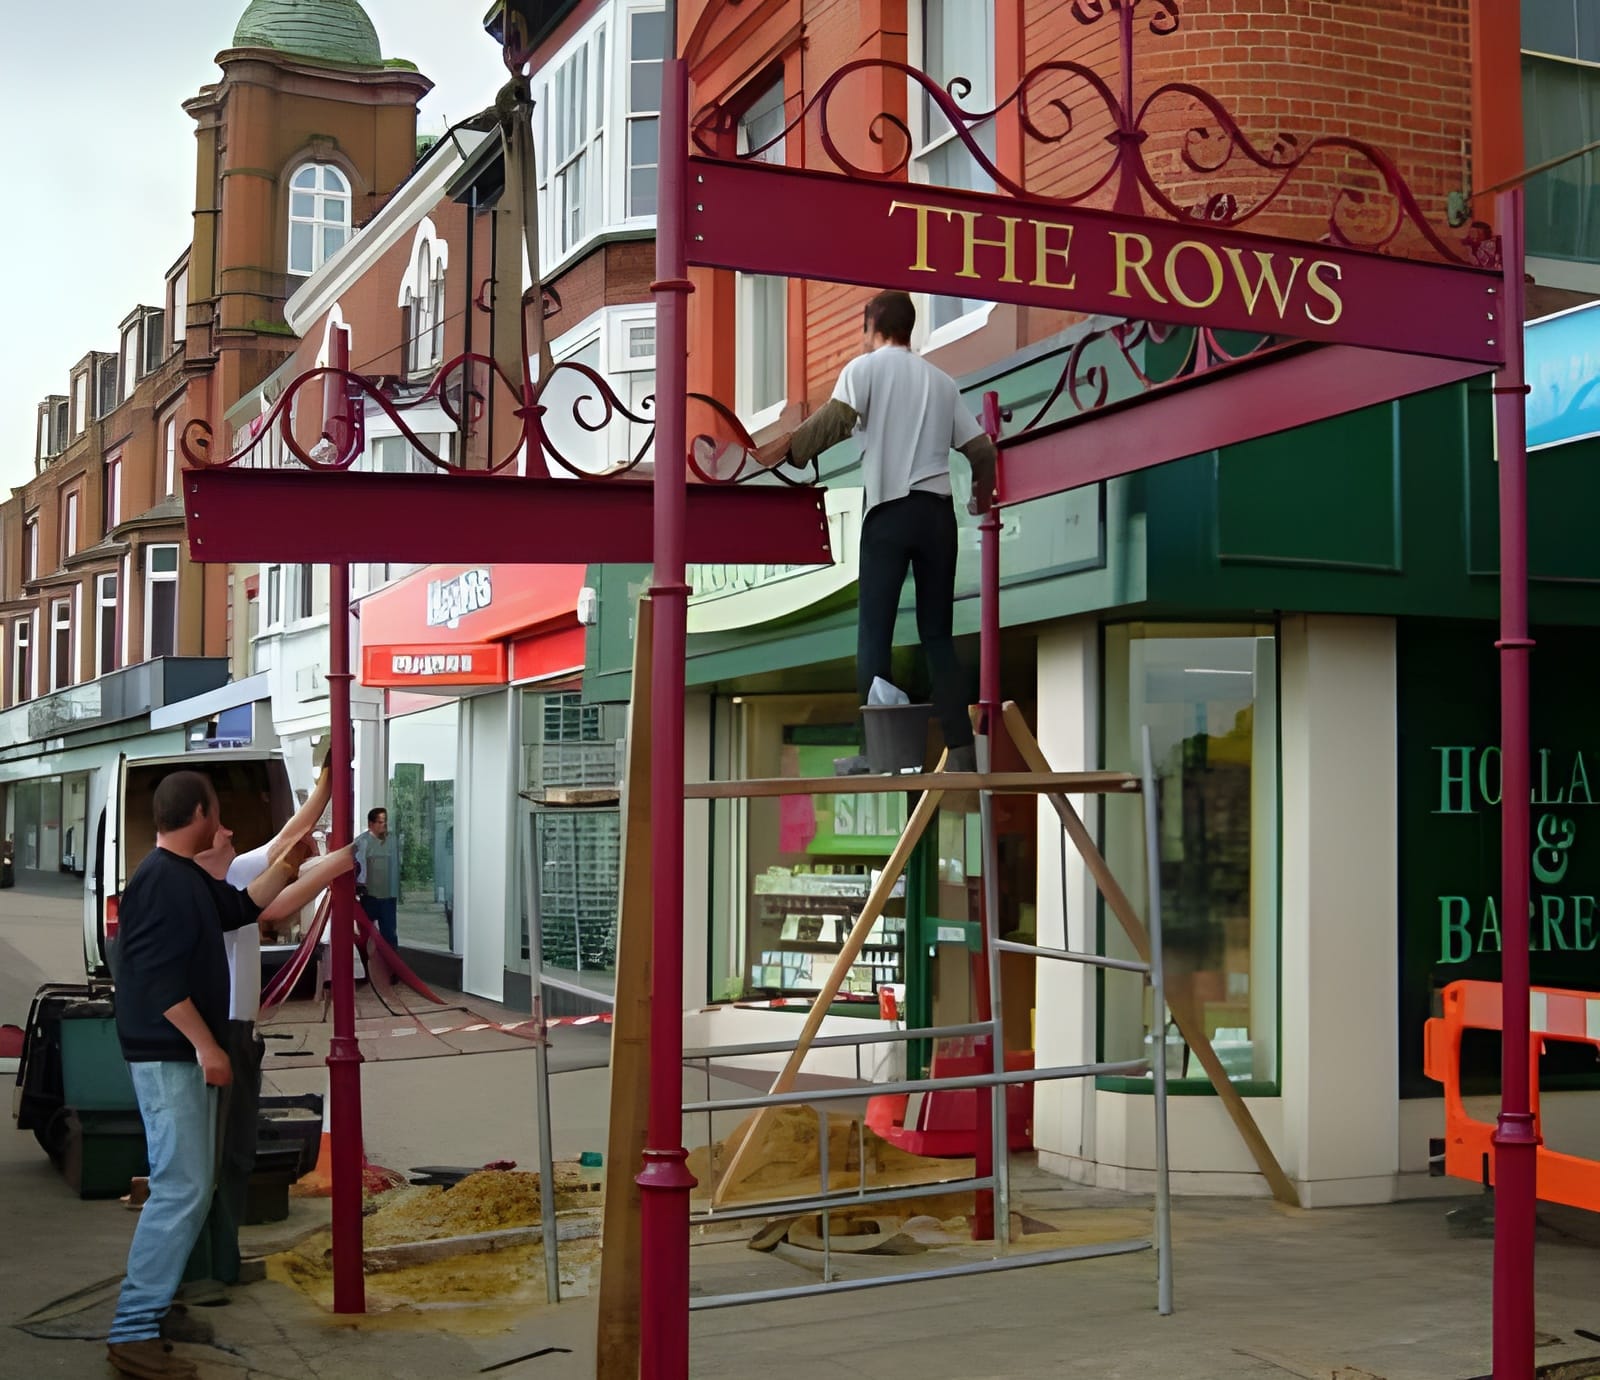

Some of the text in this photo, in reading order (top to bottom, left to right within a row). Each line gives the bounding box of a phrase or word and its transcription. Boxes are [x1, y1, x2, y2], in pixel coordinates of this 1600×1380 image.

[888, 200, 1344, 325] THE ROWS
[1431, 746, 1600, 813] HOLA
[1532, 813, 1576, 884] &
[1436, 895, 1600, 964] BARE
